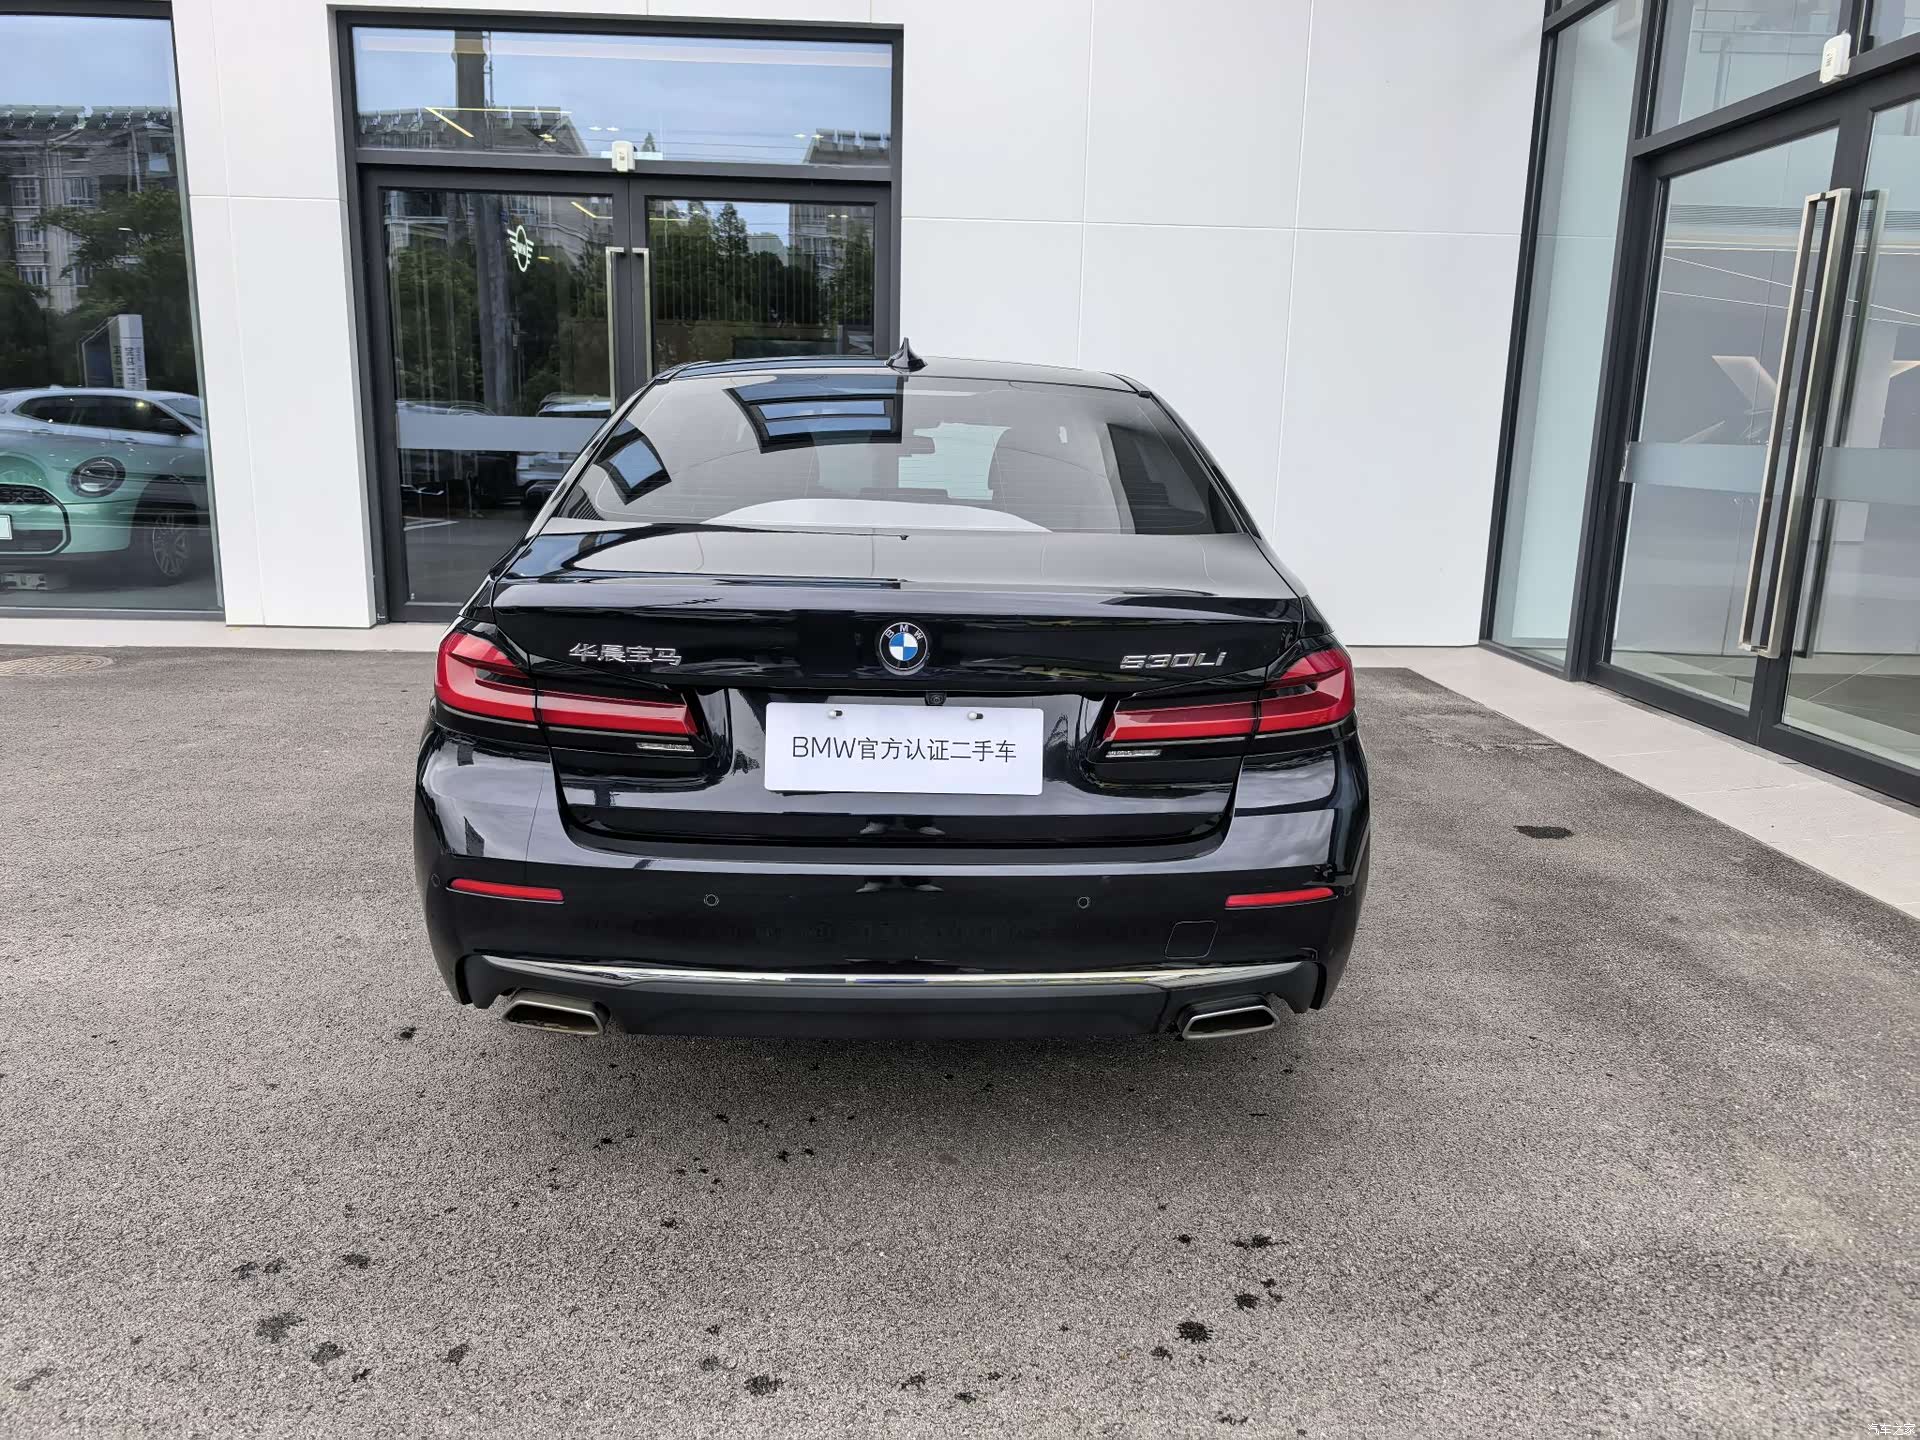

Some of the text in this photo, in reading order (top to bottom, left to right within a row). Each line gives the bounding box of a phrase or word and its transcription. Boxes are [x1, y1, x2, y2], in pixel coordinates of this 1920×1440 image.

[884, 624, 924, 640] BMW
[568, 642, 682, 666] 华晨宝马
[1120, 651, 1227, 669] 530Li
[792, 736, 1017, 763] BMW官方认证二手车
